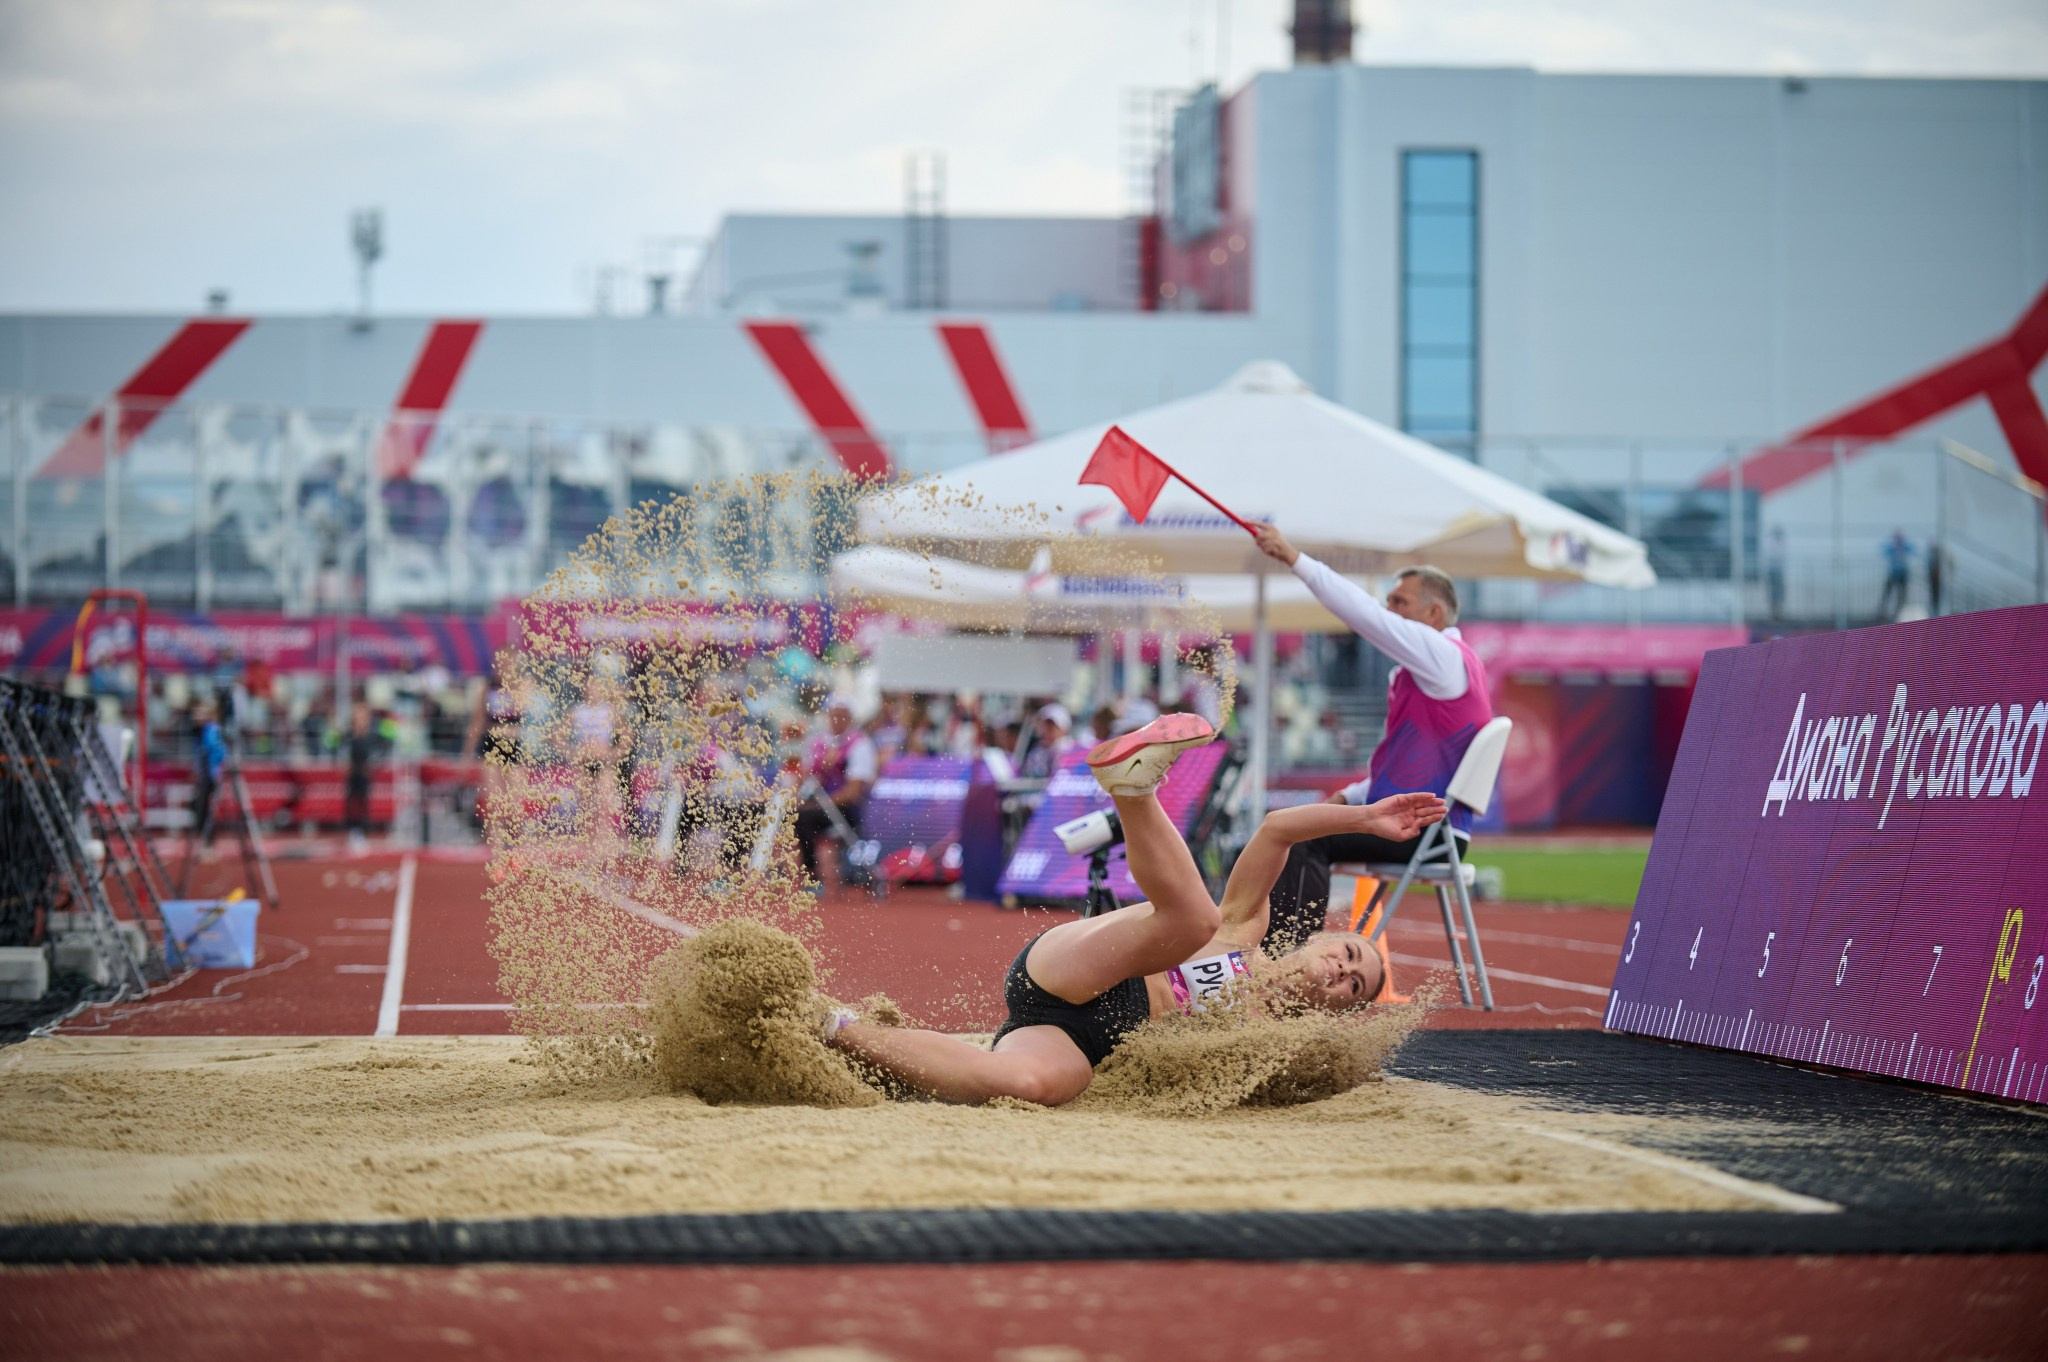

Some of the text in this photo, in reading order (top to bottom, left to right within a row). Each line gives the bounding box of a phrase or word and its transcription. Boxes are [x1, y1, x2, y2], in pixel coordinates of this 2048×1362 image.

[1761, 683, 2048, 830] Диана Русакова
[1625, 921, 2045, 1010] 3 4 5 6 7 8
